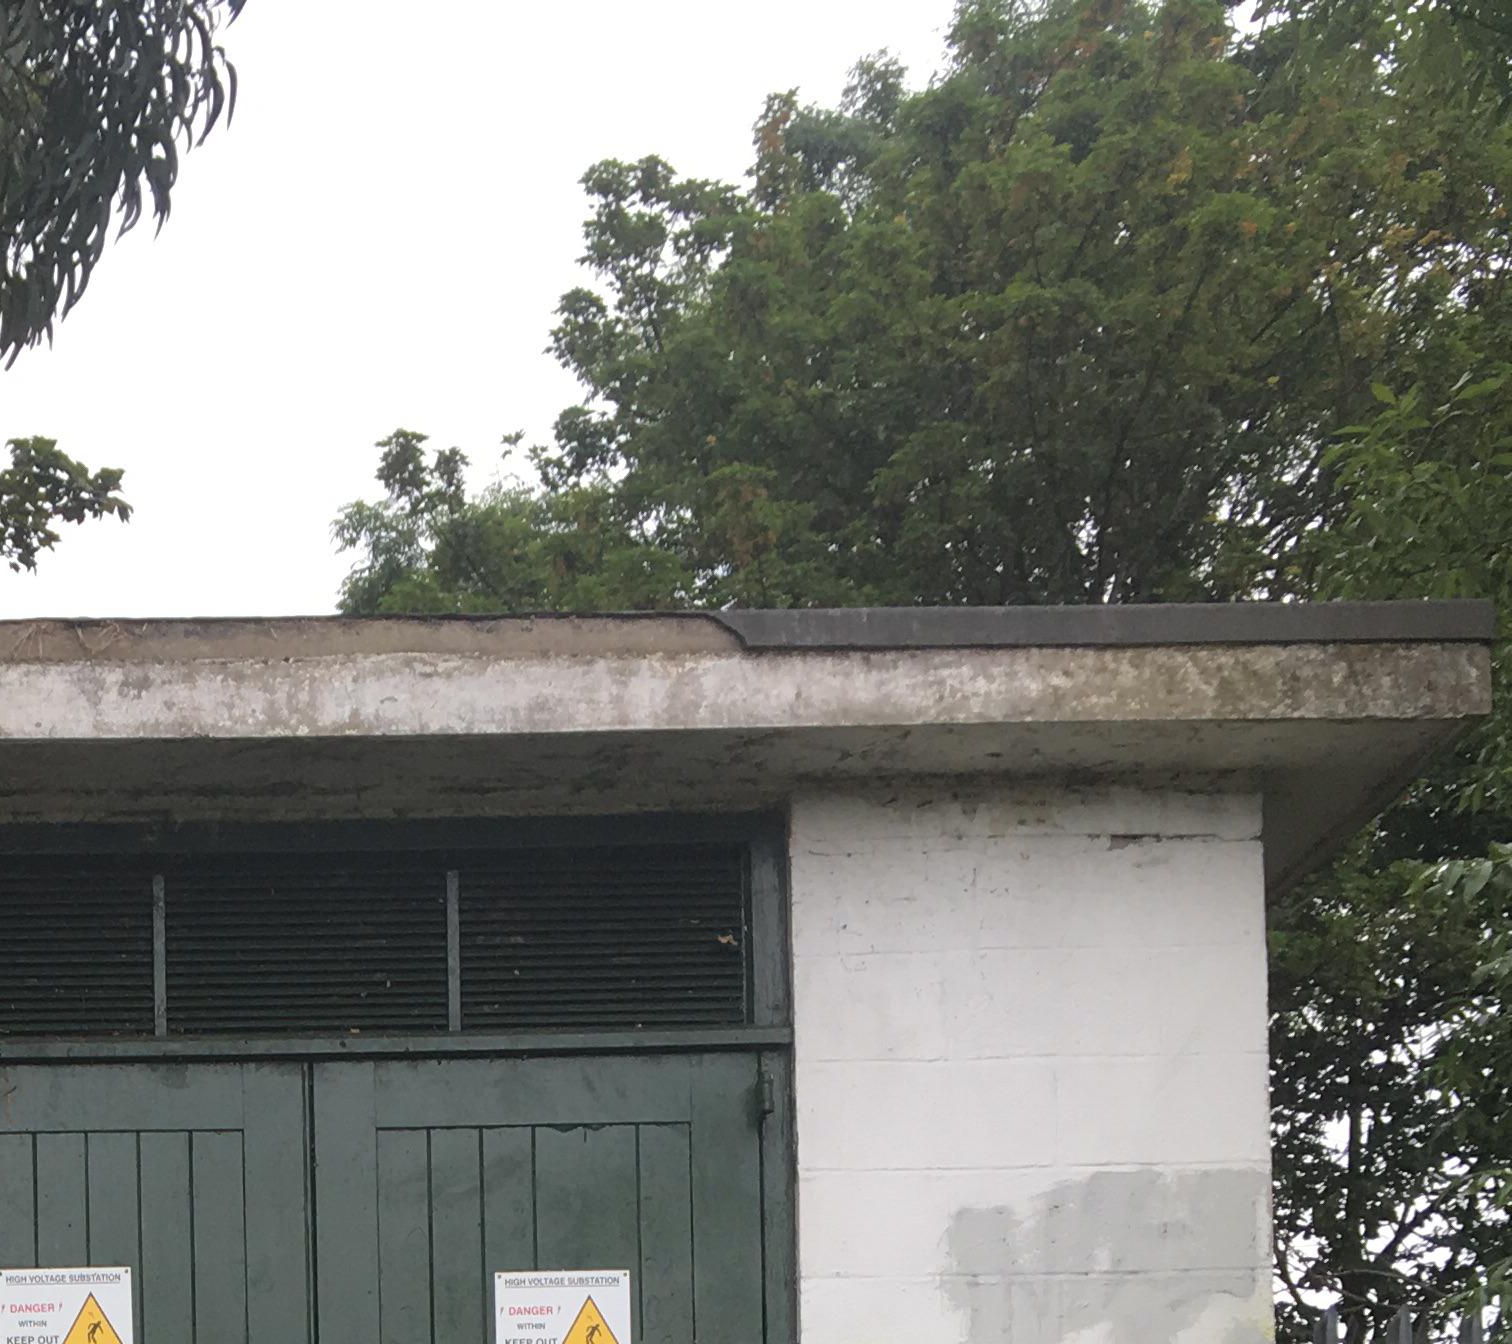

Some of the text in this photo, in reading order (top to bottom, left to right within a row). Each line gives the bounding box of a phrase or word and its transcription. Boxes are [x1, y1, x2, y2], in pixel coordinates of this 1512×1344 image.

[6, 1273, 120, 1283] HIGH VOLTAGE SUBSTATION
[505, 1278, 526, 1286] HIGH
[568, 1277, 619, 1285] SUBSTATION
[10, 1304, 54, 1313] DANGER
[509, 1306, 553, 1315] DANGER
[7, 1336, 59, 1344] KEEP OUT
